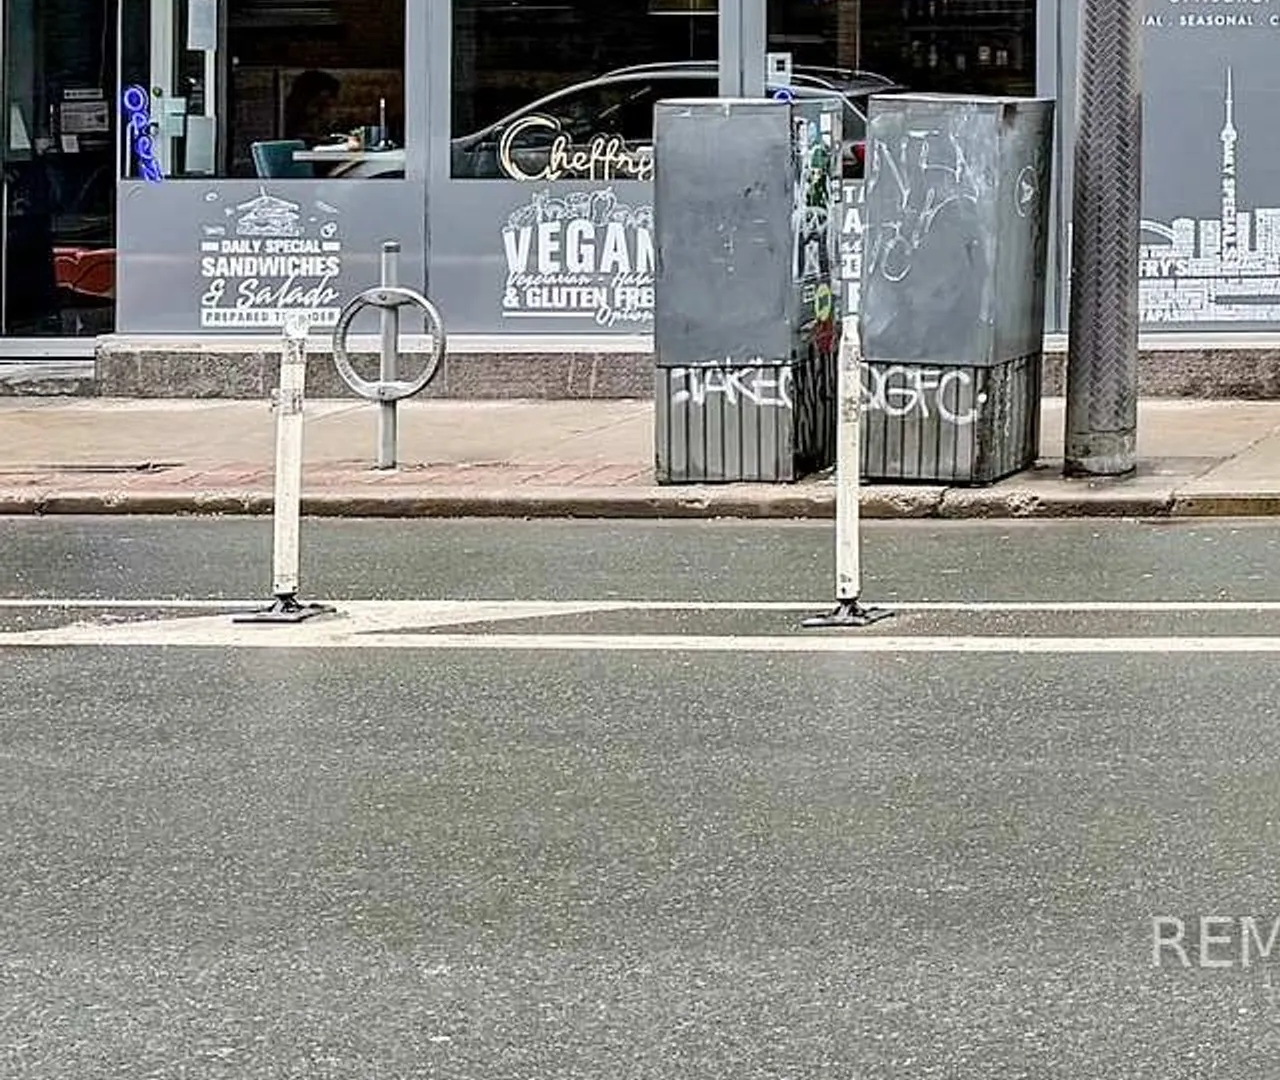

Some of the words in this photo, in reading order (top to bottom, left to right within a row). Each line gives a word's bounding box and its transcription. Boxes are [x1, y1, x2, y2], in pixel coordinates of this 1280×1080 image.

[1180, 15, 1253, 26] SEASONAL
[499, 112, 655, 181] Cheffry
[221, 239, 262, 253] DAILY
[264, 239, 322, 253] SPECIAL
[502, 219, 655, 273] VEGAN
[201, 256, 340, 277] SANDWICHES
[1139, 259, 1188, 277] FRY'S
[236, 272, 340, 308] Salads
[502, 287, 520, 308] &
[525, 286, 607, 308] GLUTEN
[614, 286, 655, 308] FRE
[205, 312, 269, 322] PREPARED
